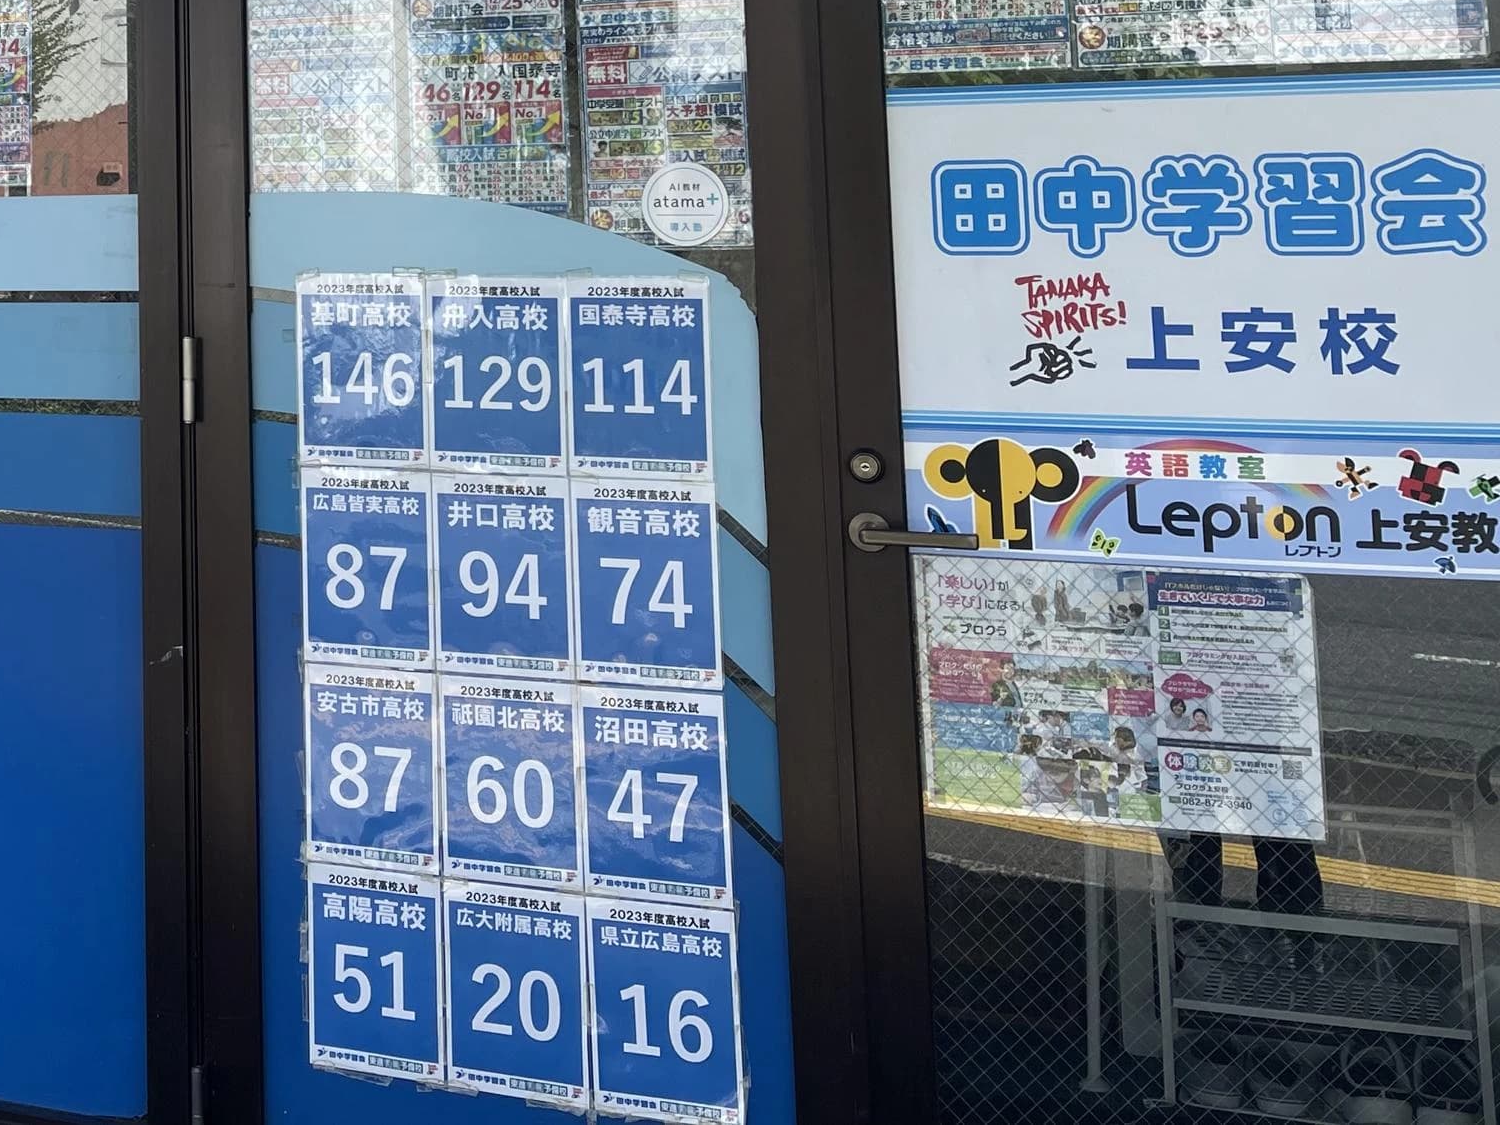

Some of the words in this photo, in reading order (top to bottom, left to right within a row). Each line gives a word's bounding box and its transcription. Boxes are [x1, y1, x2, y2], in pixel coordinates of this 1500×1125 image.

[587, 64, 626, 83] 無料
[909, 56, 984, 71] 田中学習会
[463, 81, 500, 101] 129
[514, 79, 551, 99] 114
[515, 108, 543, 118] No.1
[667, 105, 713, 118] 大予想!
[695, 120, 711, 130] 26
[931, 148, 1488, 259] 田中学習会
[317, 283, 405, 294] 2023年度高校入試
[449, 285, 541, 297] 2023年度高校入試
[587, 286, 685, 298] 2023年度高校入試
[1015, 273, 1111, 309] TANAKA
[311, 301, 413, 328] 基町高校
[442, 304, 549, 331] 舟入高校
[579, 304, 696, 328] 国泰寺高校
[1021, 301, 1127, 340] SPIRITS!
[1126, 306, 1401, 375] 上安校
[312, 352, 415, 407] 146
[443, 354, 551, 412] 129
[583, 357, 698, 415] 114
[1125, 452, 1266, 480] 英語教室
[321, 478, 410, 490] 2023年度高校入試
[454, 483, 547, 497] 2023年度高校入試
[594, 488, 692, 502] 2023年度高校入試
[313, 493, 420, 516] 広島皆実高校
[448, 501, 555, 532] 井口高校
[1126, 483, 1342, 553] Lepton
[587, 506, 701, 538] 観音高校
[1356, 510, 1500, 555] 上安教
[1285, 544, 1342, 558] レプトン
[326, 543, 408, 611] 87
[459, 550, 548, 620] 94
[600, 557, 693, 629] 74
[326, 674, 415, 691] 2023年度高校入試
[461, 685, 555, 702] 2023年度高校入試
[317, 691, 425, 721] 安古市高校
[600, 696, 699, 714] 2023年度高校入試
[595, 715, 709, 751] 沼田高校
[329, 742, 412, 813] 87
[467, 755, 555, 829] 60
[607, 769, 699, 843] 47
[1182, 797, 1252, 811] 082-872-3940
[329, 874, 419, 894] 2023年度高校入試
[322, 892, 426, 932] 高陽高校
[466, 891, 562, 913] 2023年度高校入試
[456, 908, 572, 941] 広大附属高校
[609, 908, 711, 930] 2023年度高校入試
[601, 926, 723, 959] 県立広島高校
[333, 943, 416, 1022] 51
[472, 963, 561, 1042] 20
[619, 983, 714, 1063] 16
